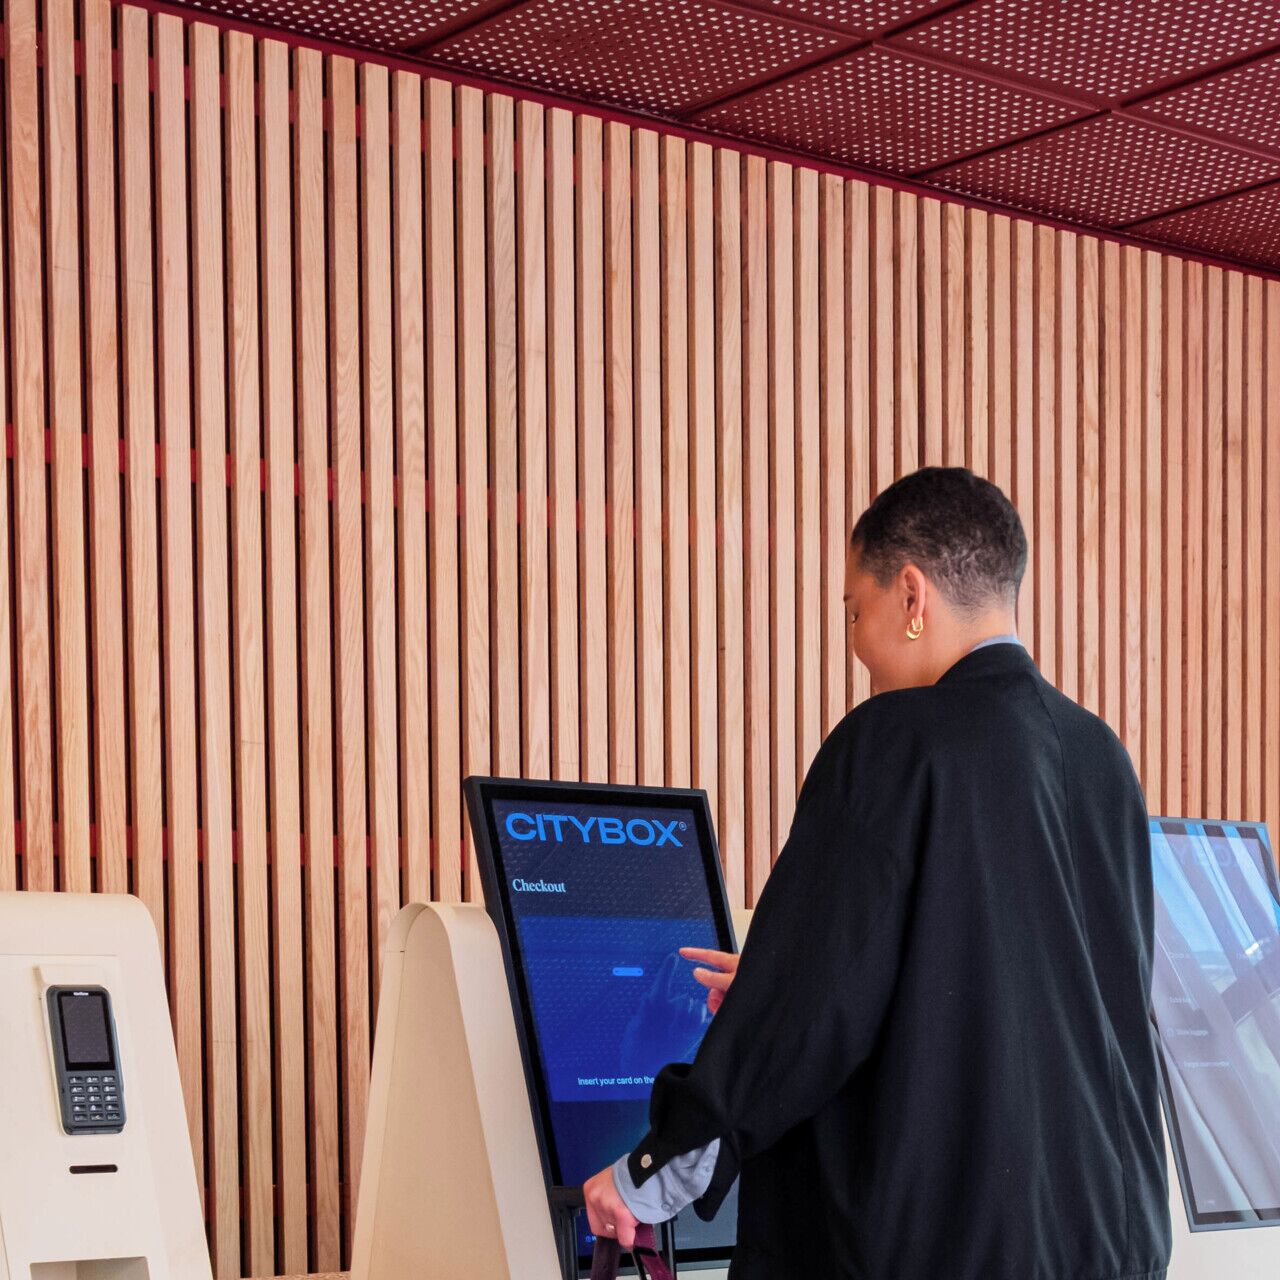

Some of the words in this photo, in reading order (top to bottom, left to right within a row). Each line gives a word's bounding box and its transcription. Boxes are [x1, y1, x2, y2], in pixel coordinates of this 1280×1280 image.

[512, 878, 567, 893] Checkout
[578, 1077, 599, 1086] Insert
[600, 1078, 615, 1087] your
[616, 1077, 632, 1085] card
